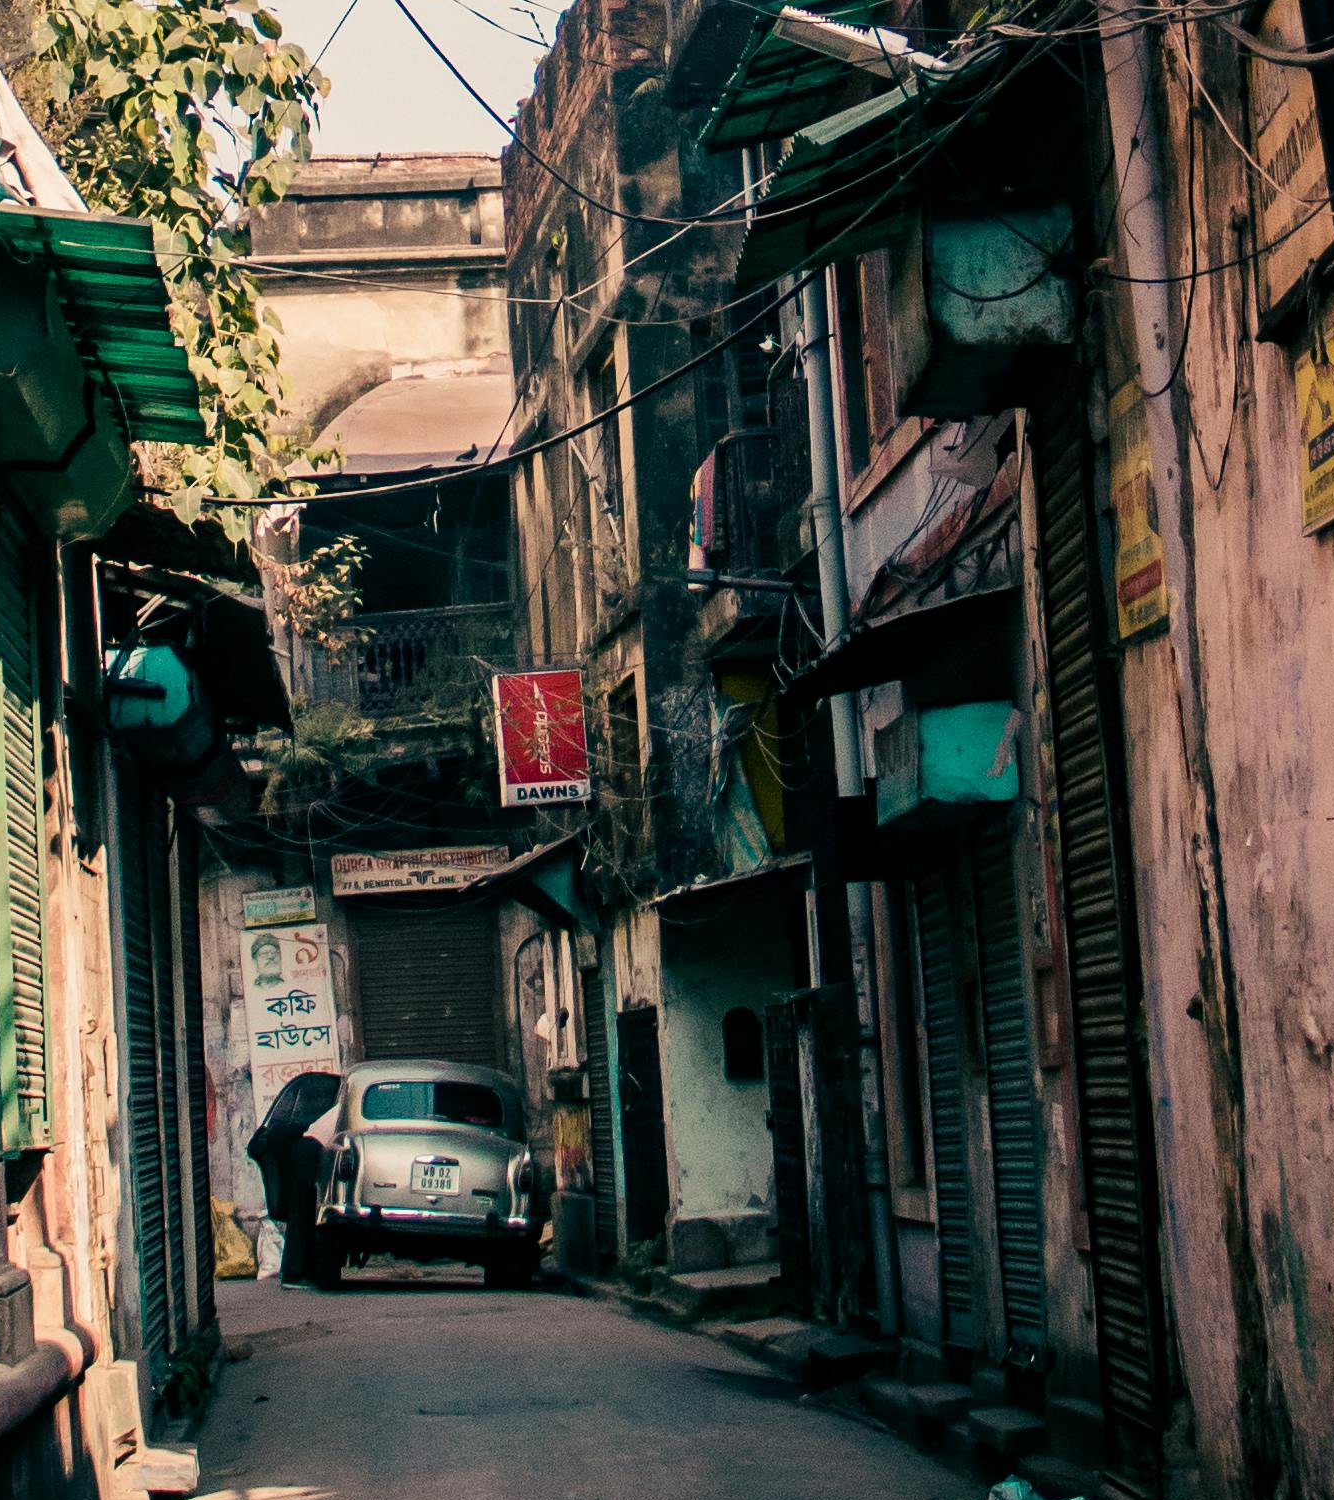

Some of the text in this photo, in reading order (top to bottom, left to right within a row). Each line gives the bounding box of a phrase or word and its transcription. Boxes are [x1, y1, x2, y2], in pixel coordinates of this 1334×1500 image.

[517, 784, 579, 801] DAWNS
[334, 856, 373, 873] DURGA
[265, 989, 317, 1017] কফি
[255, 1024, 331, 1050] হাউসে
[423, 1166, 451, 1179] WB 02
